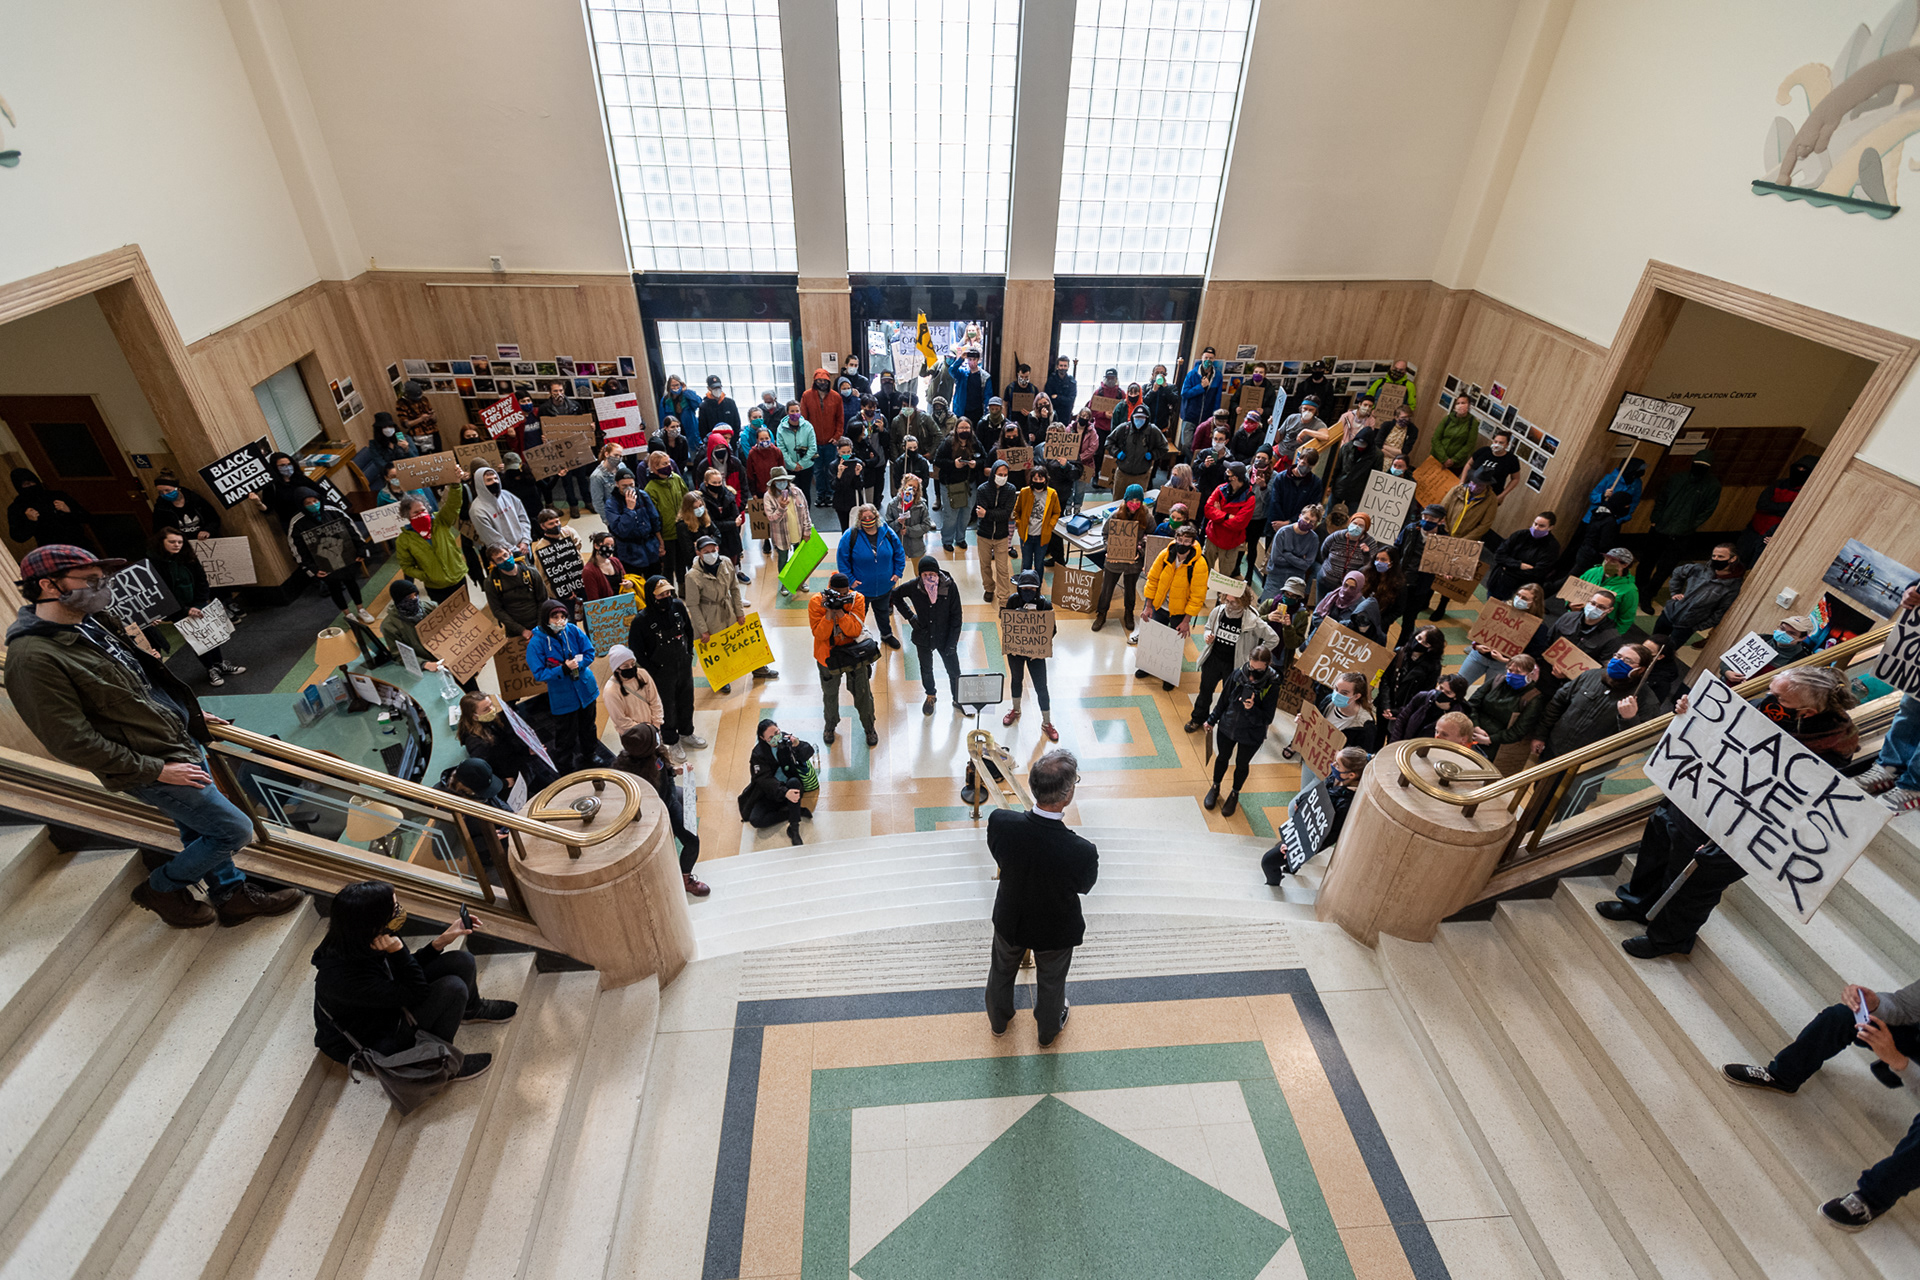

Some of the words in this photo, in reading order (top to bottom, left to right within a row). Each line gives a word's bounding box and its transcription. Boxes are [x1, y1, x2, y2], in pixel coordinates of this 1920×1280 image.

[481, 406, 496, 419] TOO
[496, 396, 513, 410] MANY
[484, 413, 502, 426] COPS
[501, 404, 515, 418] ARE
[1623, 395, 1647, 408] FUCK
[1648, 399, 1669, 414] EVERY
[487, 410, 525, 438] MURDERERS
[1613, 421, 1649, 436] NOTHING
[1650, 429, 1675, 443] LESS
[526, 441, 573, 460] DEFUND
[544, 450, 566, 461] THE
[209, 449, 254, 478] BLACK
[543, 459, 582, 474] POLICE
[220, 463, 259, 489] LIVES
[420, 475, 440, 485] 2020
[224, 472, 274, 504] MATTER
[1372, 475, 1413, 501] BLACK
[363, 505, 401, 523] DEFUND
[1363, 494, 1403, 518] LIVES
[1109, 520, 1139, 538] BLACK
[1369, 514, 1400, 541] ATTER
[1109, 536, 1134, 547] LIVES
[1427, 535, 1481, 558] DEFUND
[1064, 570, 1096, 588] INVEST
[1061, 594, 1093, 611] COMMUNITY
[1074, 586, 1090, 597] OUR
[418, 591, 467, 638] RESPECT
[1003, 612, 1047, 625] DISARM
[176, 617, 200, 636] YOU
[191, 623, 214, 641] RIGHT
[425, 604, 479, 652] EXISTENCE
[454, 629, 466, 639] OR
[1003, 624, 1047, 635] DEFUND
[1219, 631, 1237, 642] IVES
[449, 624, 482, 656] EXPECT
[1003, 634, 1048, 646] DISBAND
[1327, 629, 1372, 663] DEFUND
[1473, 628, 1523, 656] MATTER
[1746, 638, 1769, 660] BLACK
[451, 629, 505, 678] RESISTANCE
[1332, 649, 1355, 669] THE
[1545, 640, 1589, 671] BLM
[1729, 653, 1752, 673] MATTER
[1738, 645, 1765, 669] LIVES
[1308, 654, 1342, 688] POLI
[1692, 679, 1865, 839] BLACK
[1678, 716, 1833, 855] LIVES
[1307, 787, 1329, 837] BLACK
[1649, 732, 1824, 914] MATTER
[1301, 804, 1320, 853] LIVES
[1280, 817, 1306, 871] MATTER
